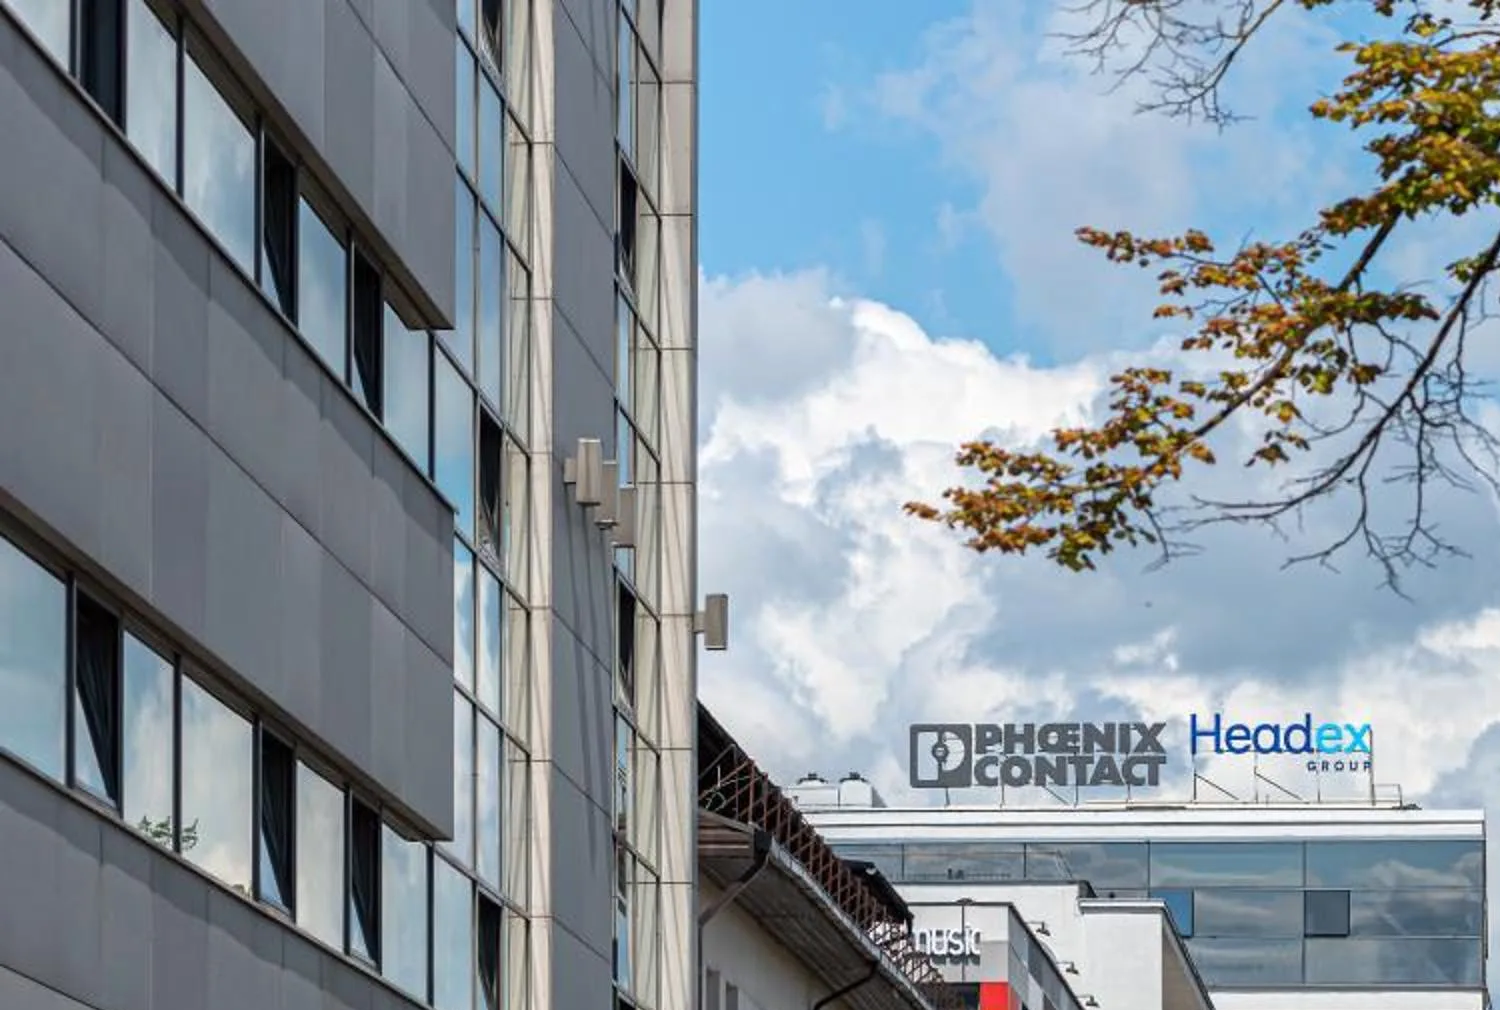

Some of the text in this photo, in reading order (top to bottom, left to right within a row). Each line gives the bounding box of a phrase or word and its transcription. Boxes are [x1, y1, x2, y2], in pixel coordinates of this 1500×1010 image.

[1190, 713, 1371, 754] Headex
[974, 755, 1167, 787] CONTACT
[1307, 760, 1371, 772] GROUP
